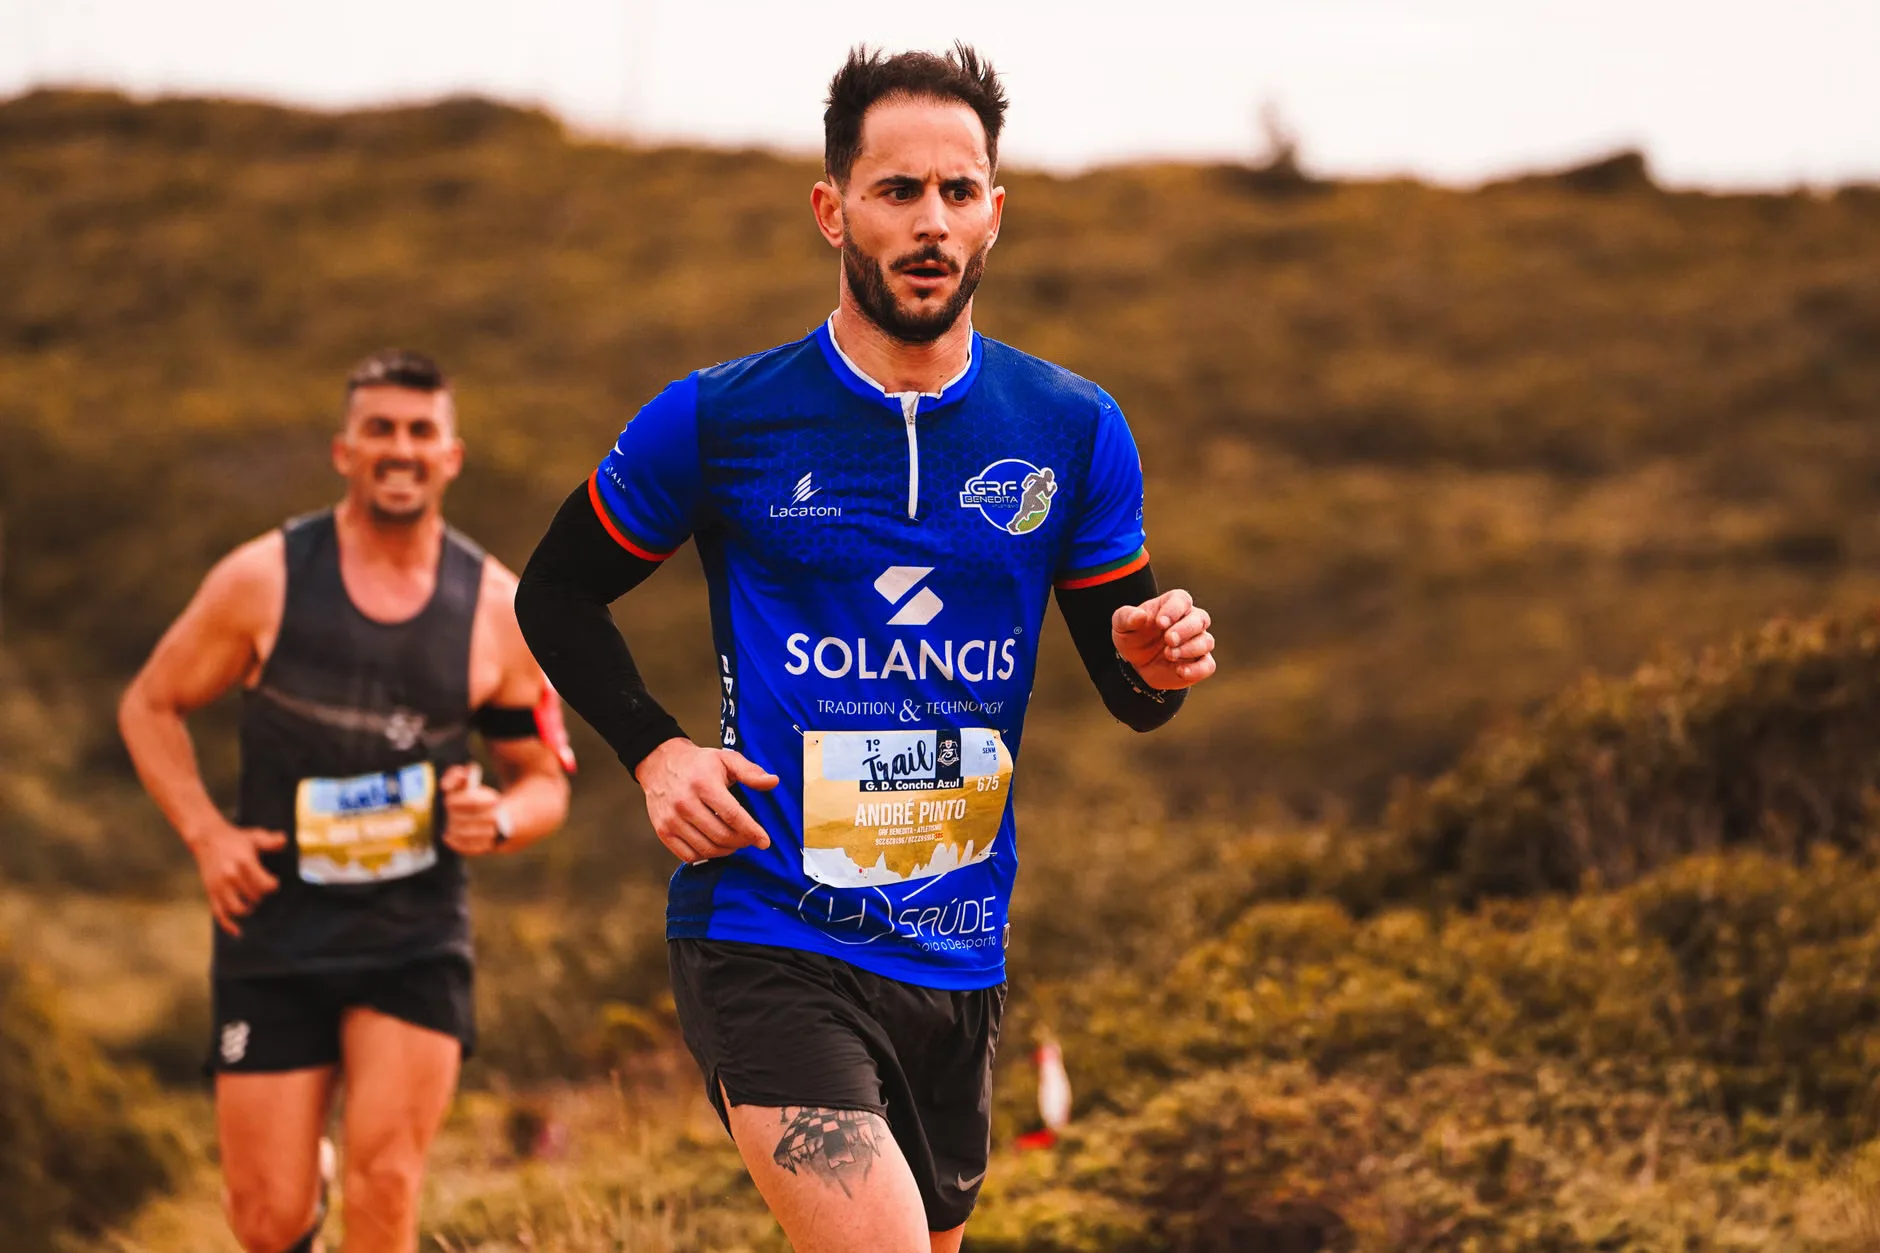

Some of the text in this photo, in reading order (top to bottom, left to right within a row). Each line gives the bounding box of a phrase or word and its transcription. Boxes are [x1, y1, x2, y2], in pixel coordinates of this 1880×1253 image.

[970, 480, 1018, 496] GRF
[964, 495, 1018, 504] BENEDITA
[769, 504, 842, 518] Lacatoni
[784, 632, 1016, 682] SOLANCIS
[816, 699, 895, 716] TRADITION
[898, 698, 922, 723] &
[862, 740, 934, 781] Trail
[865, 778, 960, 792] G. D. Concha Azul
[976, 775, 1001, 793] 675
[855, 798, 967, 827] ANDRÉ PINTO
[898, 895, 996, 939] SAÚDE
